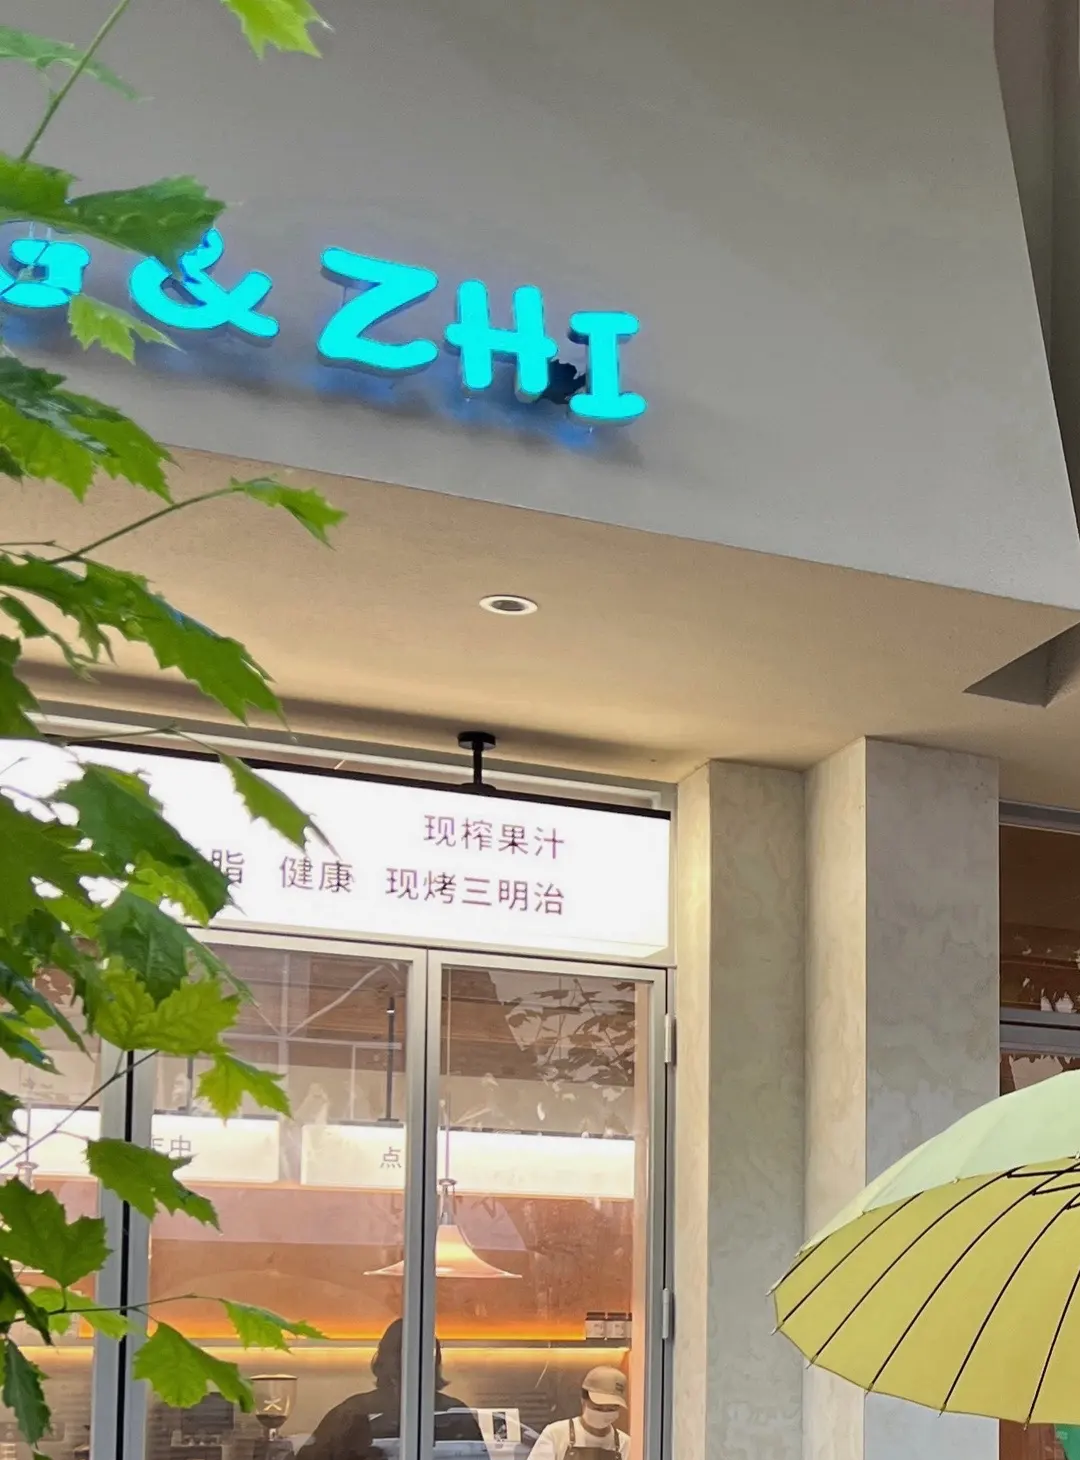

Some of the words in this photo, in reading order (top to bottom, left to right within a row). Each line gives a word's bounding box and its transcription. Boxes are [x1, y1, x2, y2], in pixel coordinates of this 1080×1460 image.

[317, 247, 647, 420] ZHI
[423, 814, 565, 859] 现榨果汁
[279, 855, 353, 893] 健康
[385, 867, 565, 915] 现烤三明治
